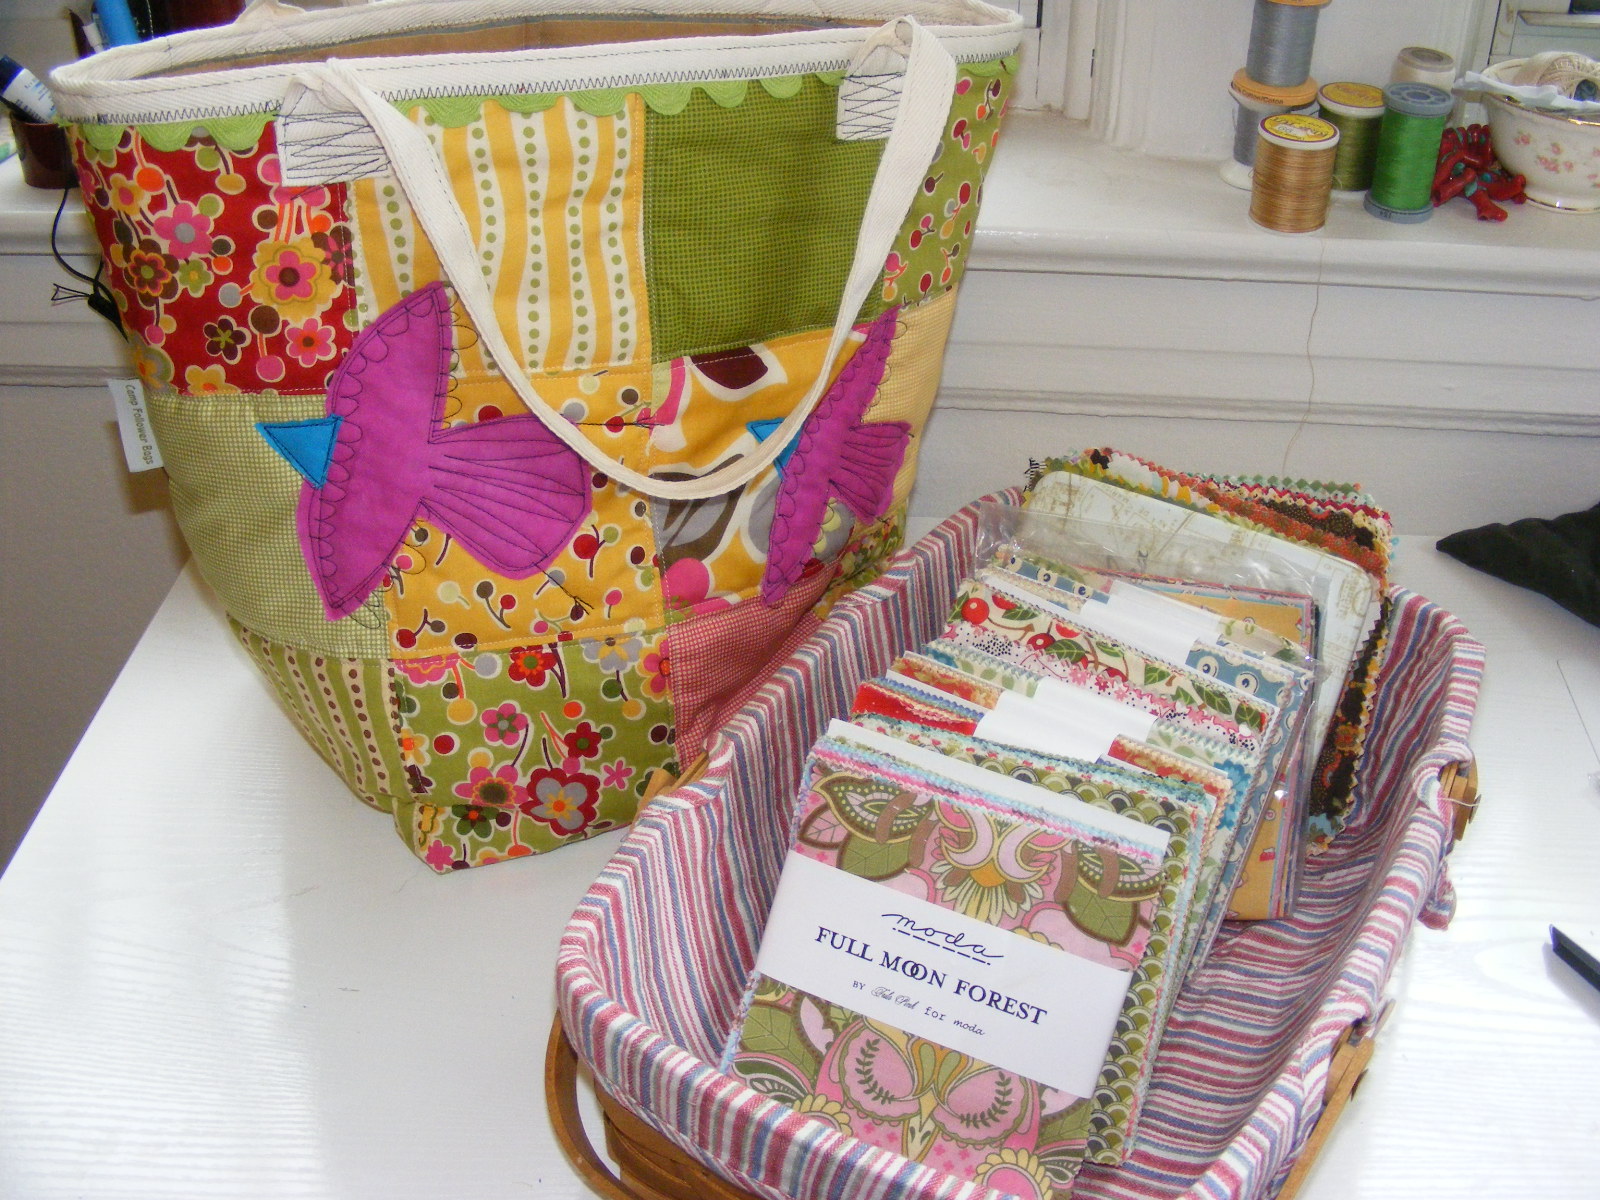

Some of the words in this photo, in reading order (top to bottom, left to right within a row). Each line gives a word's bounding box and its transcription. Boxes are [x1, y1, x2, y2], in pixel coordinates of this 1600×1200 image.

[125, 384, 138, 406] Camp
[132, 407, 148, 443] Follower
[142, 445, 154, 465] Bags
[881, 913, 1004, 958] moda
[814, 925, 874, 963] FULL
[879, 951, 948, 989] MOON
[953, 979, 1048, 1026] FOREST
[852, 980, 866, 991] BY
[924, 1006, 946, 1021] for
[953, 1018, 985, 1036] moda
